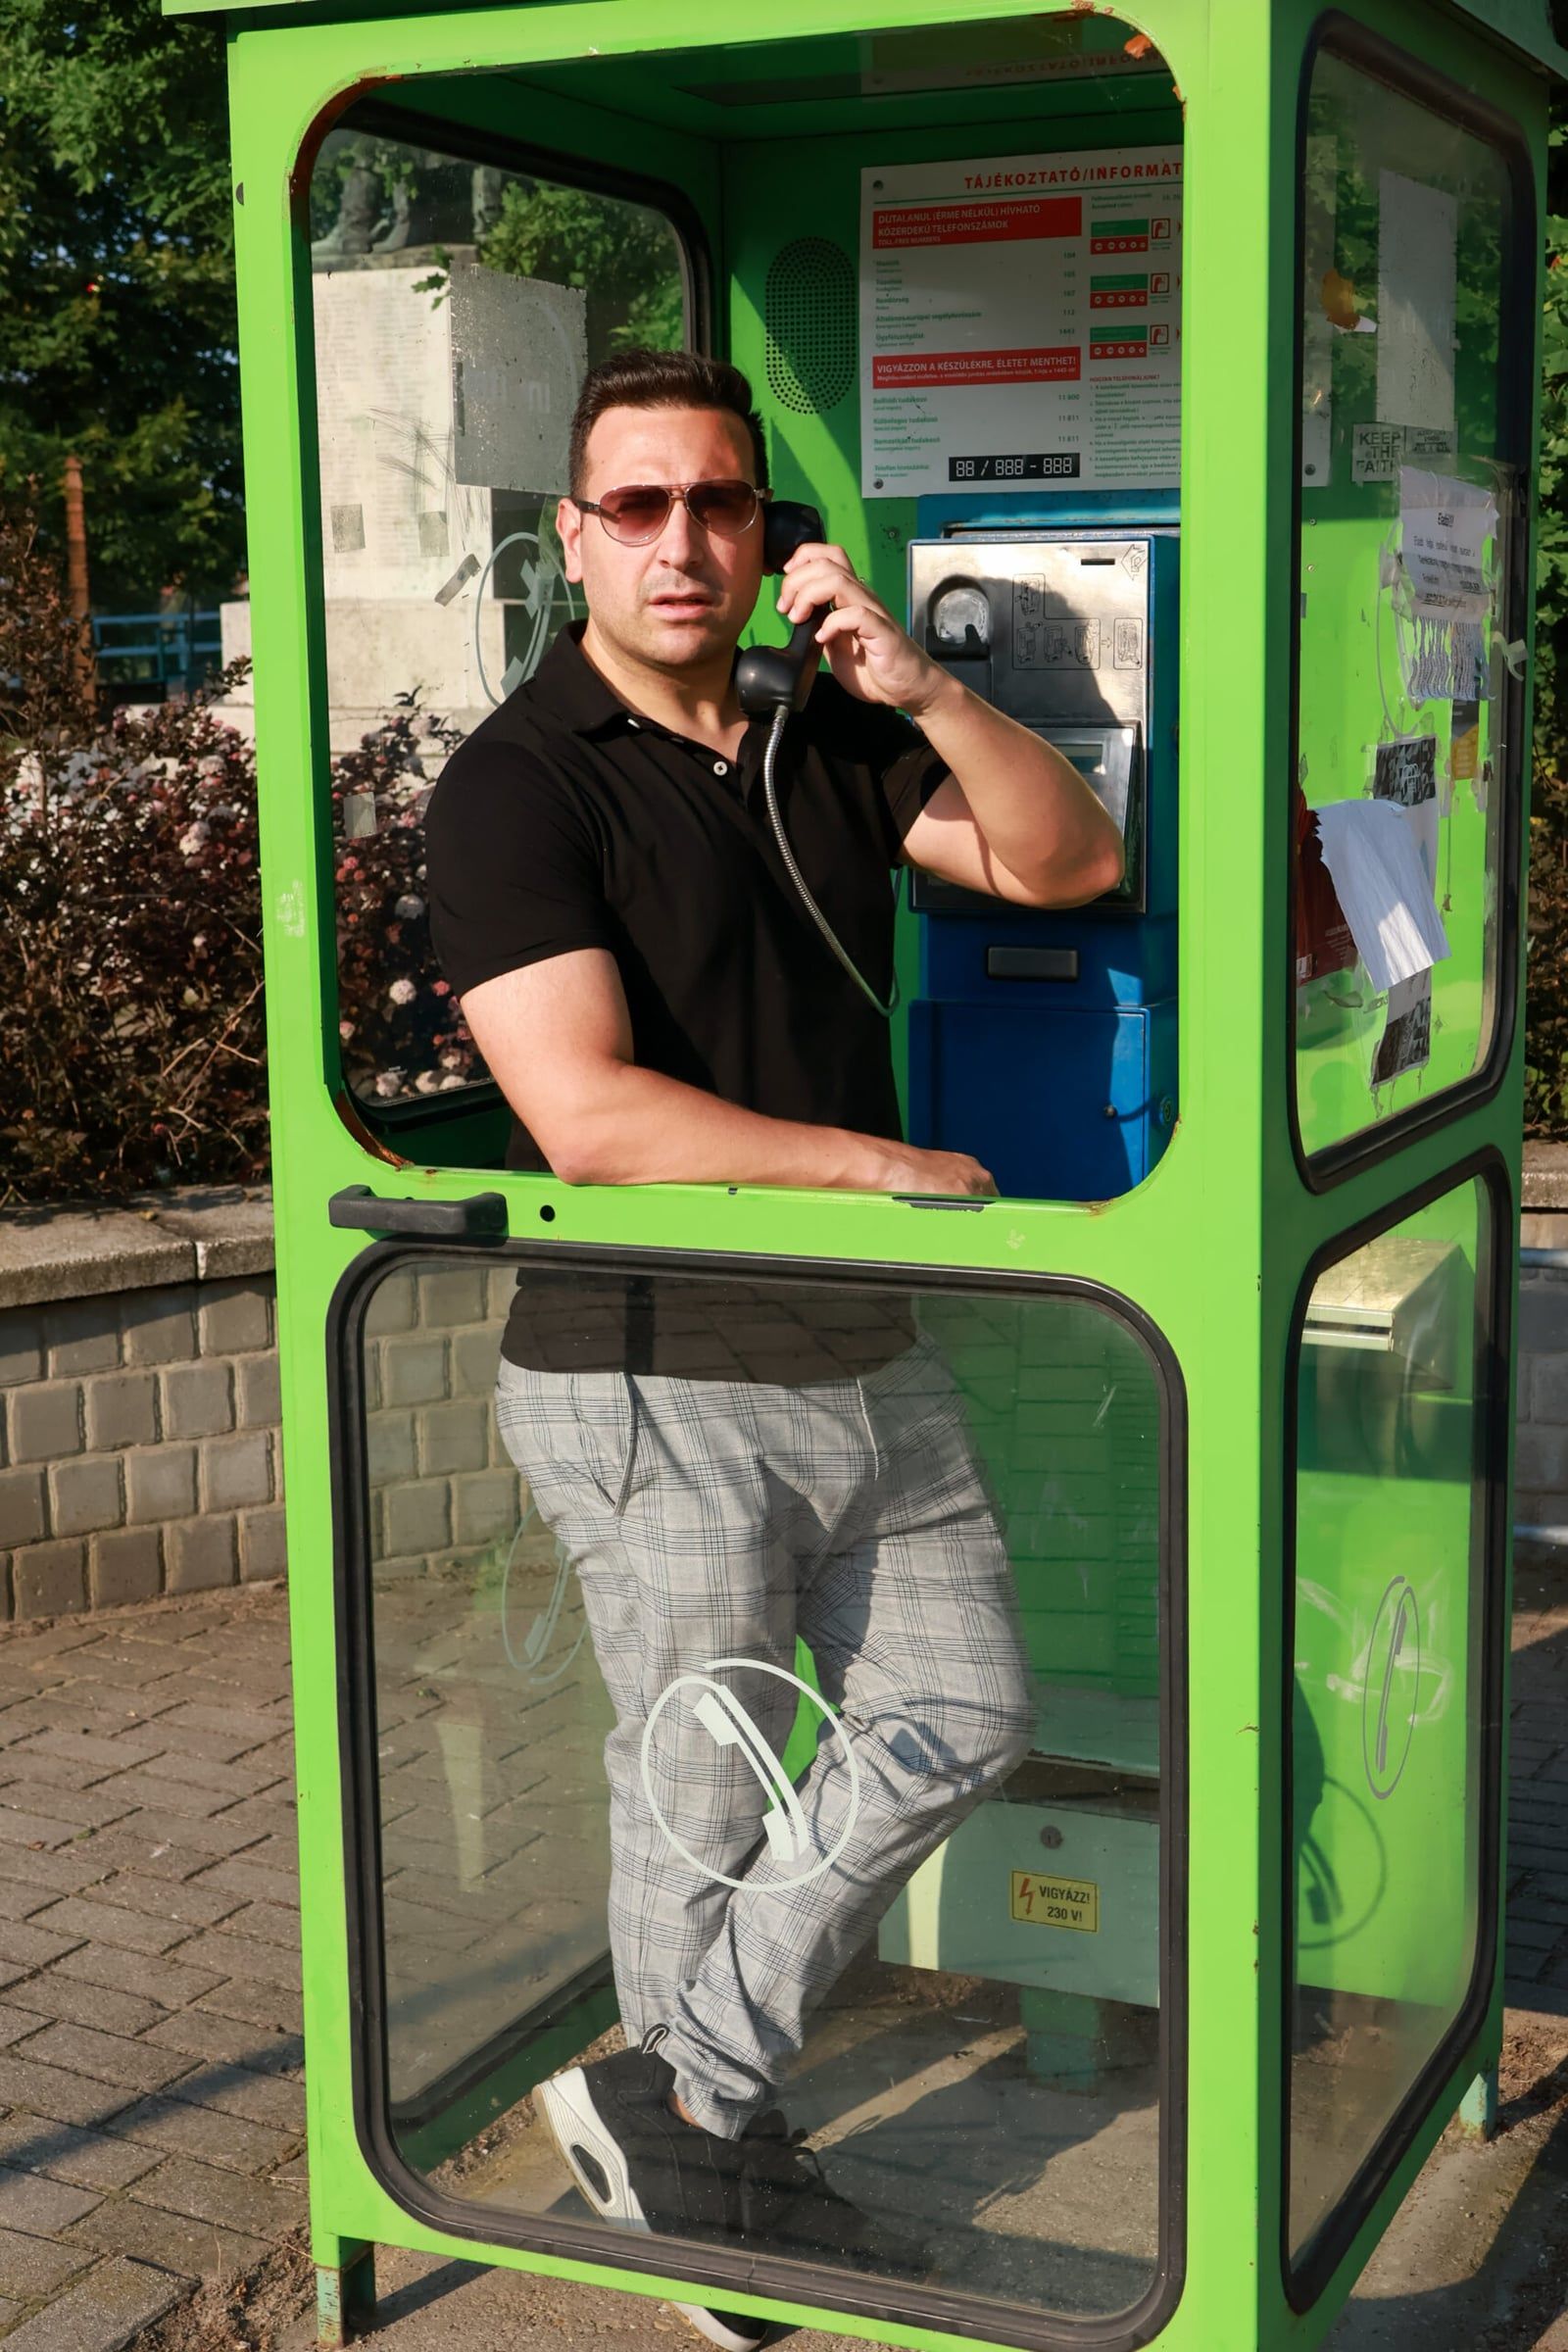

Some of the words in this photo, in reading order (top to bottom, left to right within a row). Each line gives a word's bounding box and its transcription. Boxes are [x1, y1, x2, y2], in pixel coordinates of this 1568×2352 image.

[877, 362, 927, 374] VIGYÁZZON
[929, 363, 937, 371] A
[996, 357, 1028, 368] ÉLETET
[1029, 356, 1076, 368] MENTHET!
[1359, 431, 1401, 446] KEEP
[1370, 446, 1399, 459] THE
[1039, 1886, 1090, 1904] VIGYÁZZ!
[1047, 1906, 1068, 1921] 230
[1071, 1909, 1083, 1923] V!
